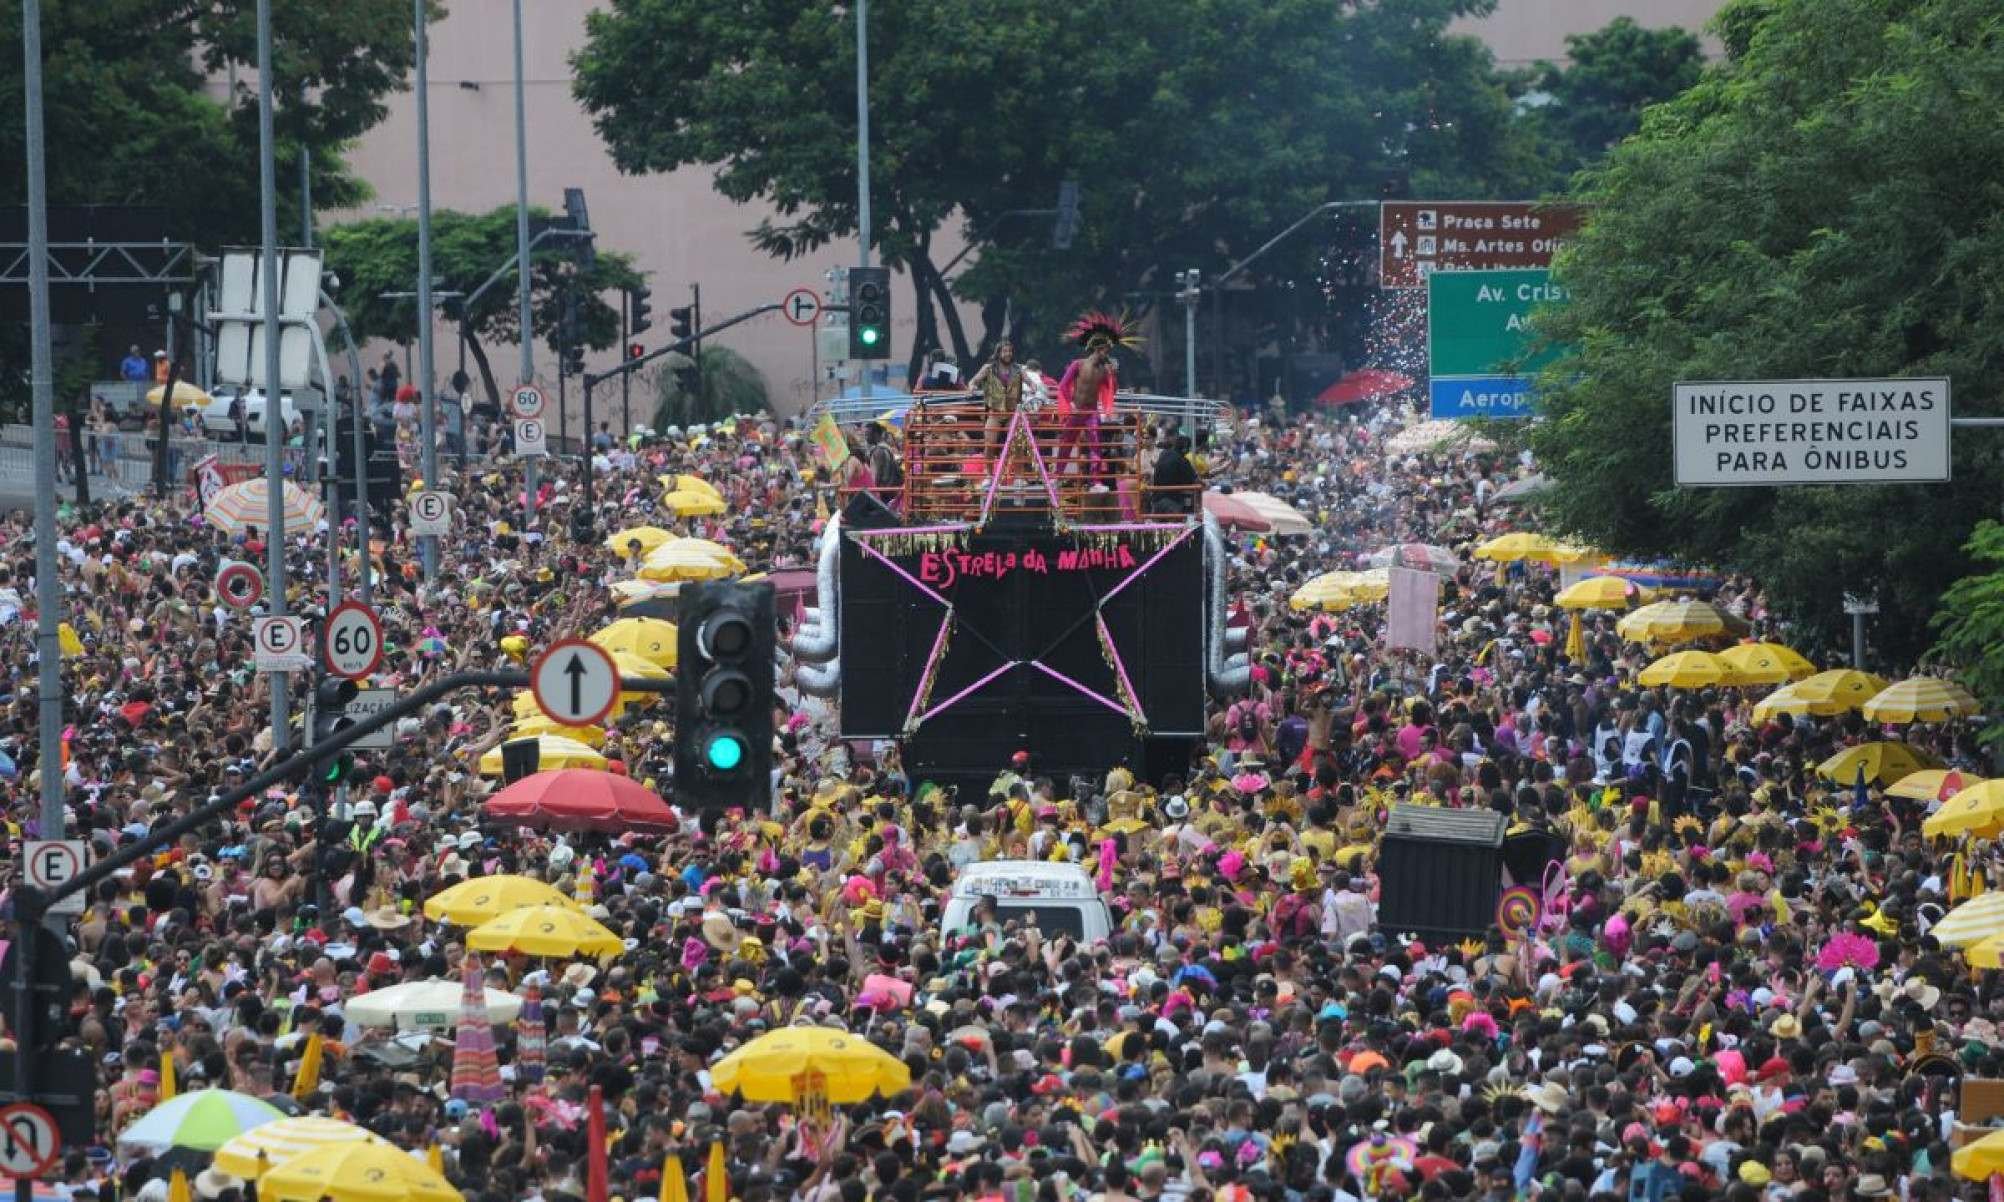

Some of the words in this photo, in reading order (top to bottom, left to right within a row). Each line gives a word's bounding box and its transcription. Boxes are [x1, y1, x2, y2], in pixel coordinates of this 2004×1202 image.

[1443, 215, 1494, 230] Praça
[1502, 214, 1541, 229] Sete
[1475, 238, 1524, 252] Artes
[1477, 284, 1505, 302] Av.
[1690, 390, 1775, 415] INÍCIO
[1790, 393, 1824, 413] DE
[1838, 390, 1934, 412] FAIXAS
[525, 424, 535, 438] E
[1706, 420, 1919, 443] PREFERENCIAIS
[1717, 451, 1788, 472] PARA
[1804, 445, 1908, 470] ÔNIBUS
[425, 498, 436, 515] E
[270, 624, 285, 647] E
[335, 625, 370, 655] 60
[46, 852, 63, 881] E
